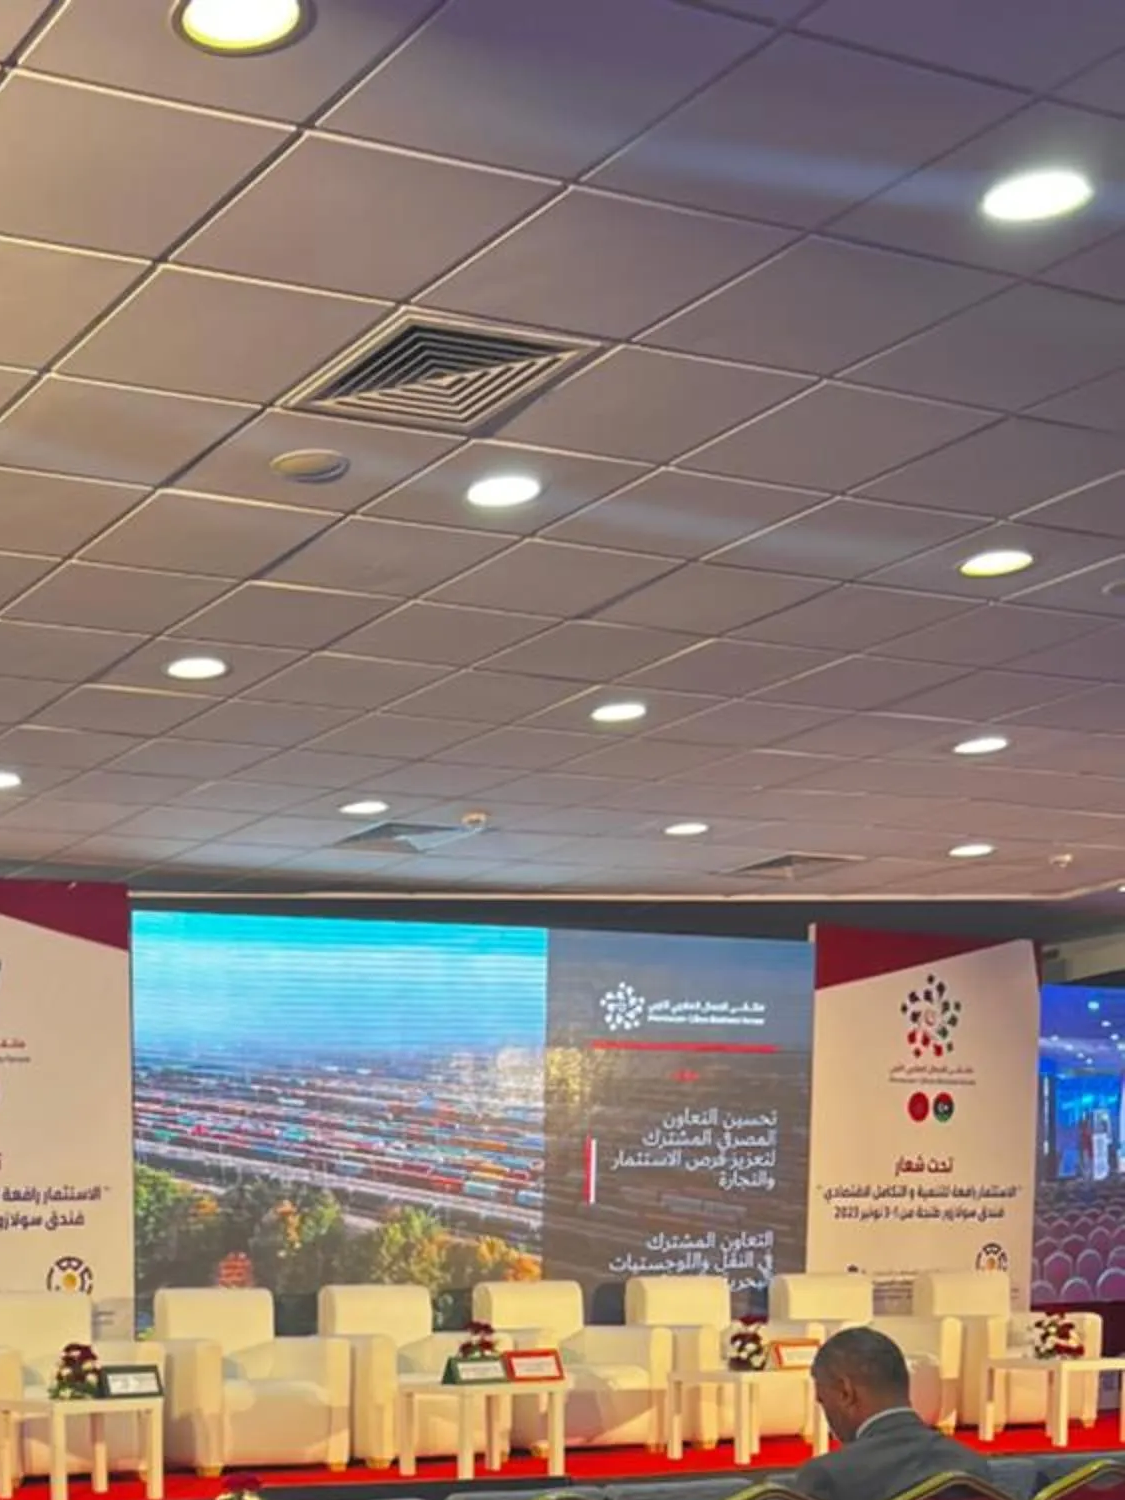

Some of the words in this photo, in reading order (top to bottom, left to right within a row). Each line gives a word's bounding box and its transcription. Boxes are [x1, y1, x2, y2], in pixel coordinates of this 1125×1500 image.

[662, 1106, 719, 1129] التعاون
[723, 1109, 778, 1129] تحسين
[641, 1128, 712, 1149] المشترك
[610, 1149, 682, 1171] الاستثمار
[719, 1170, 776, 1191] والتجارة
[2, 1186, 42, 1206] رافعة
[44, 1208, 86, 1232] فندق
[645, 1231, 716, 1252] المشترك
[720, 1230, 774, 1251] التعاون
